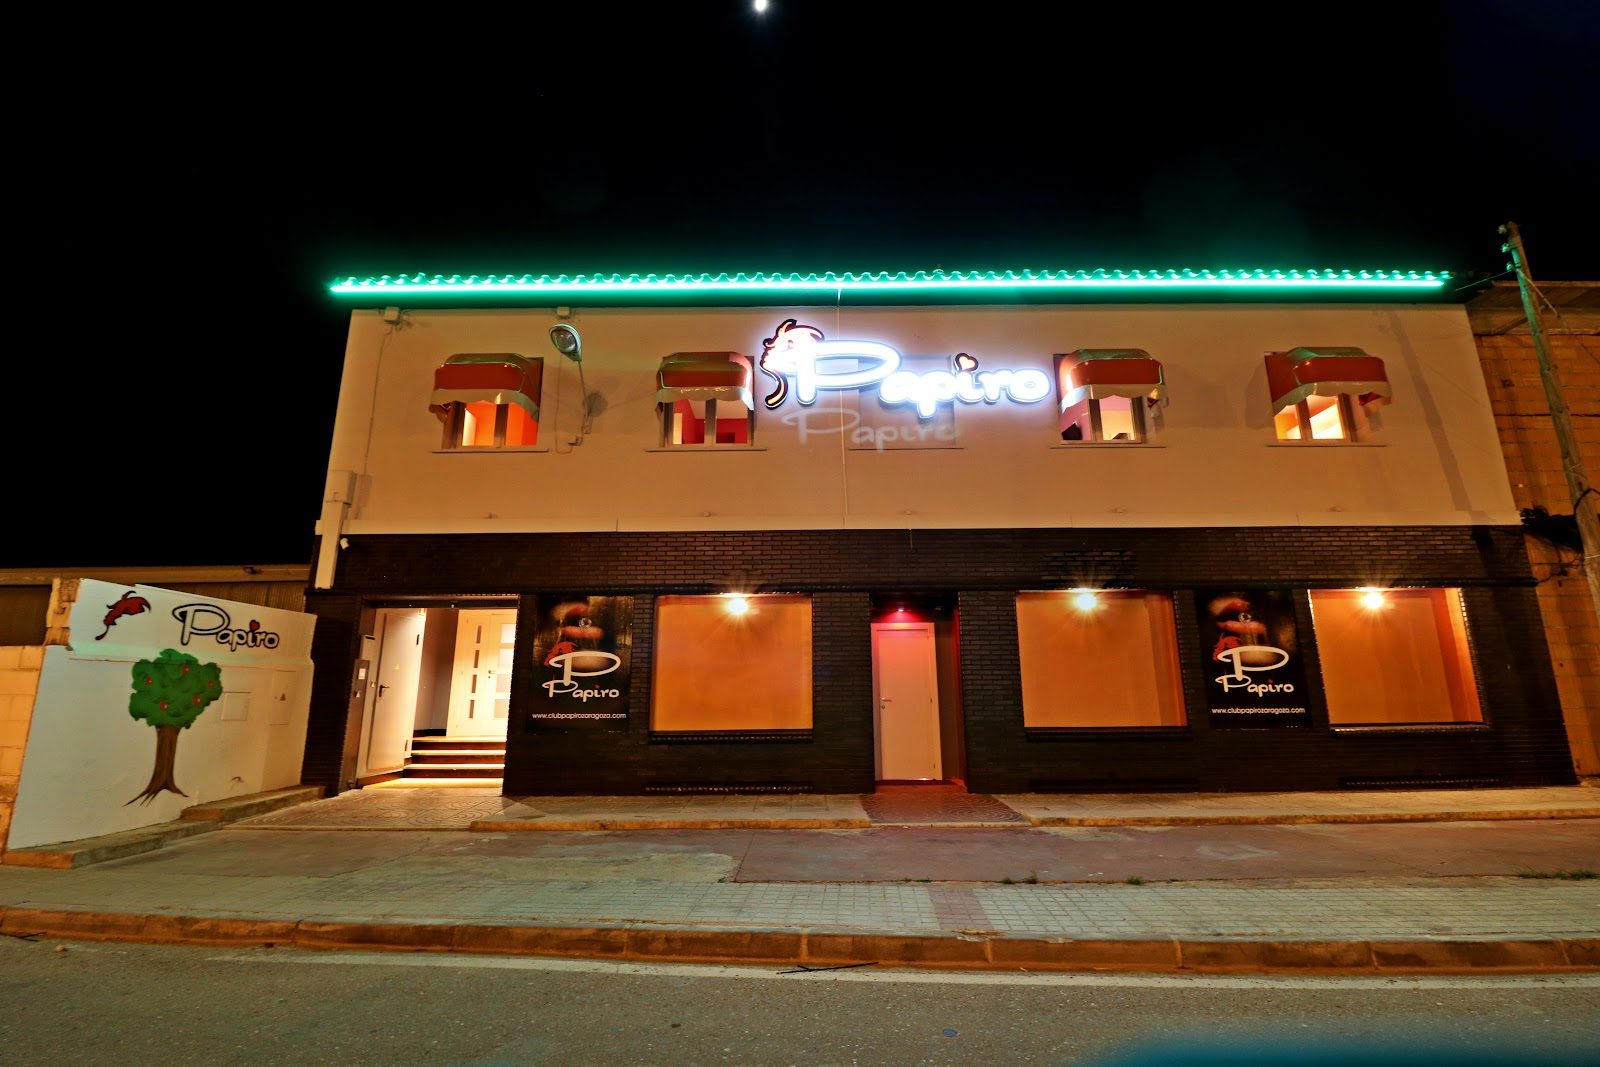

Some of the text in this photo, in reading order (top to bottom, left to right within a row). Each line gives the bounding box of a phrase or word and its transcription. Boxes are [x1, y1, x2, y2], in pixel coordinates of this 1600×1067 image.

[780, 340, 1051, 417] Papiro
[172, 603, 279, 652] Papiro
[542, 680, 620, 702] Papiro
[1215, 674, 1294, 697] Papiro
[532, 712, 627, 720] www.clubpapirozaragoza.com
[1211, 707, 1306, 715] www.clubpapirozaragoza.com
